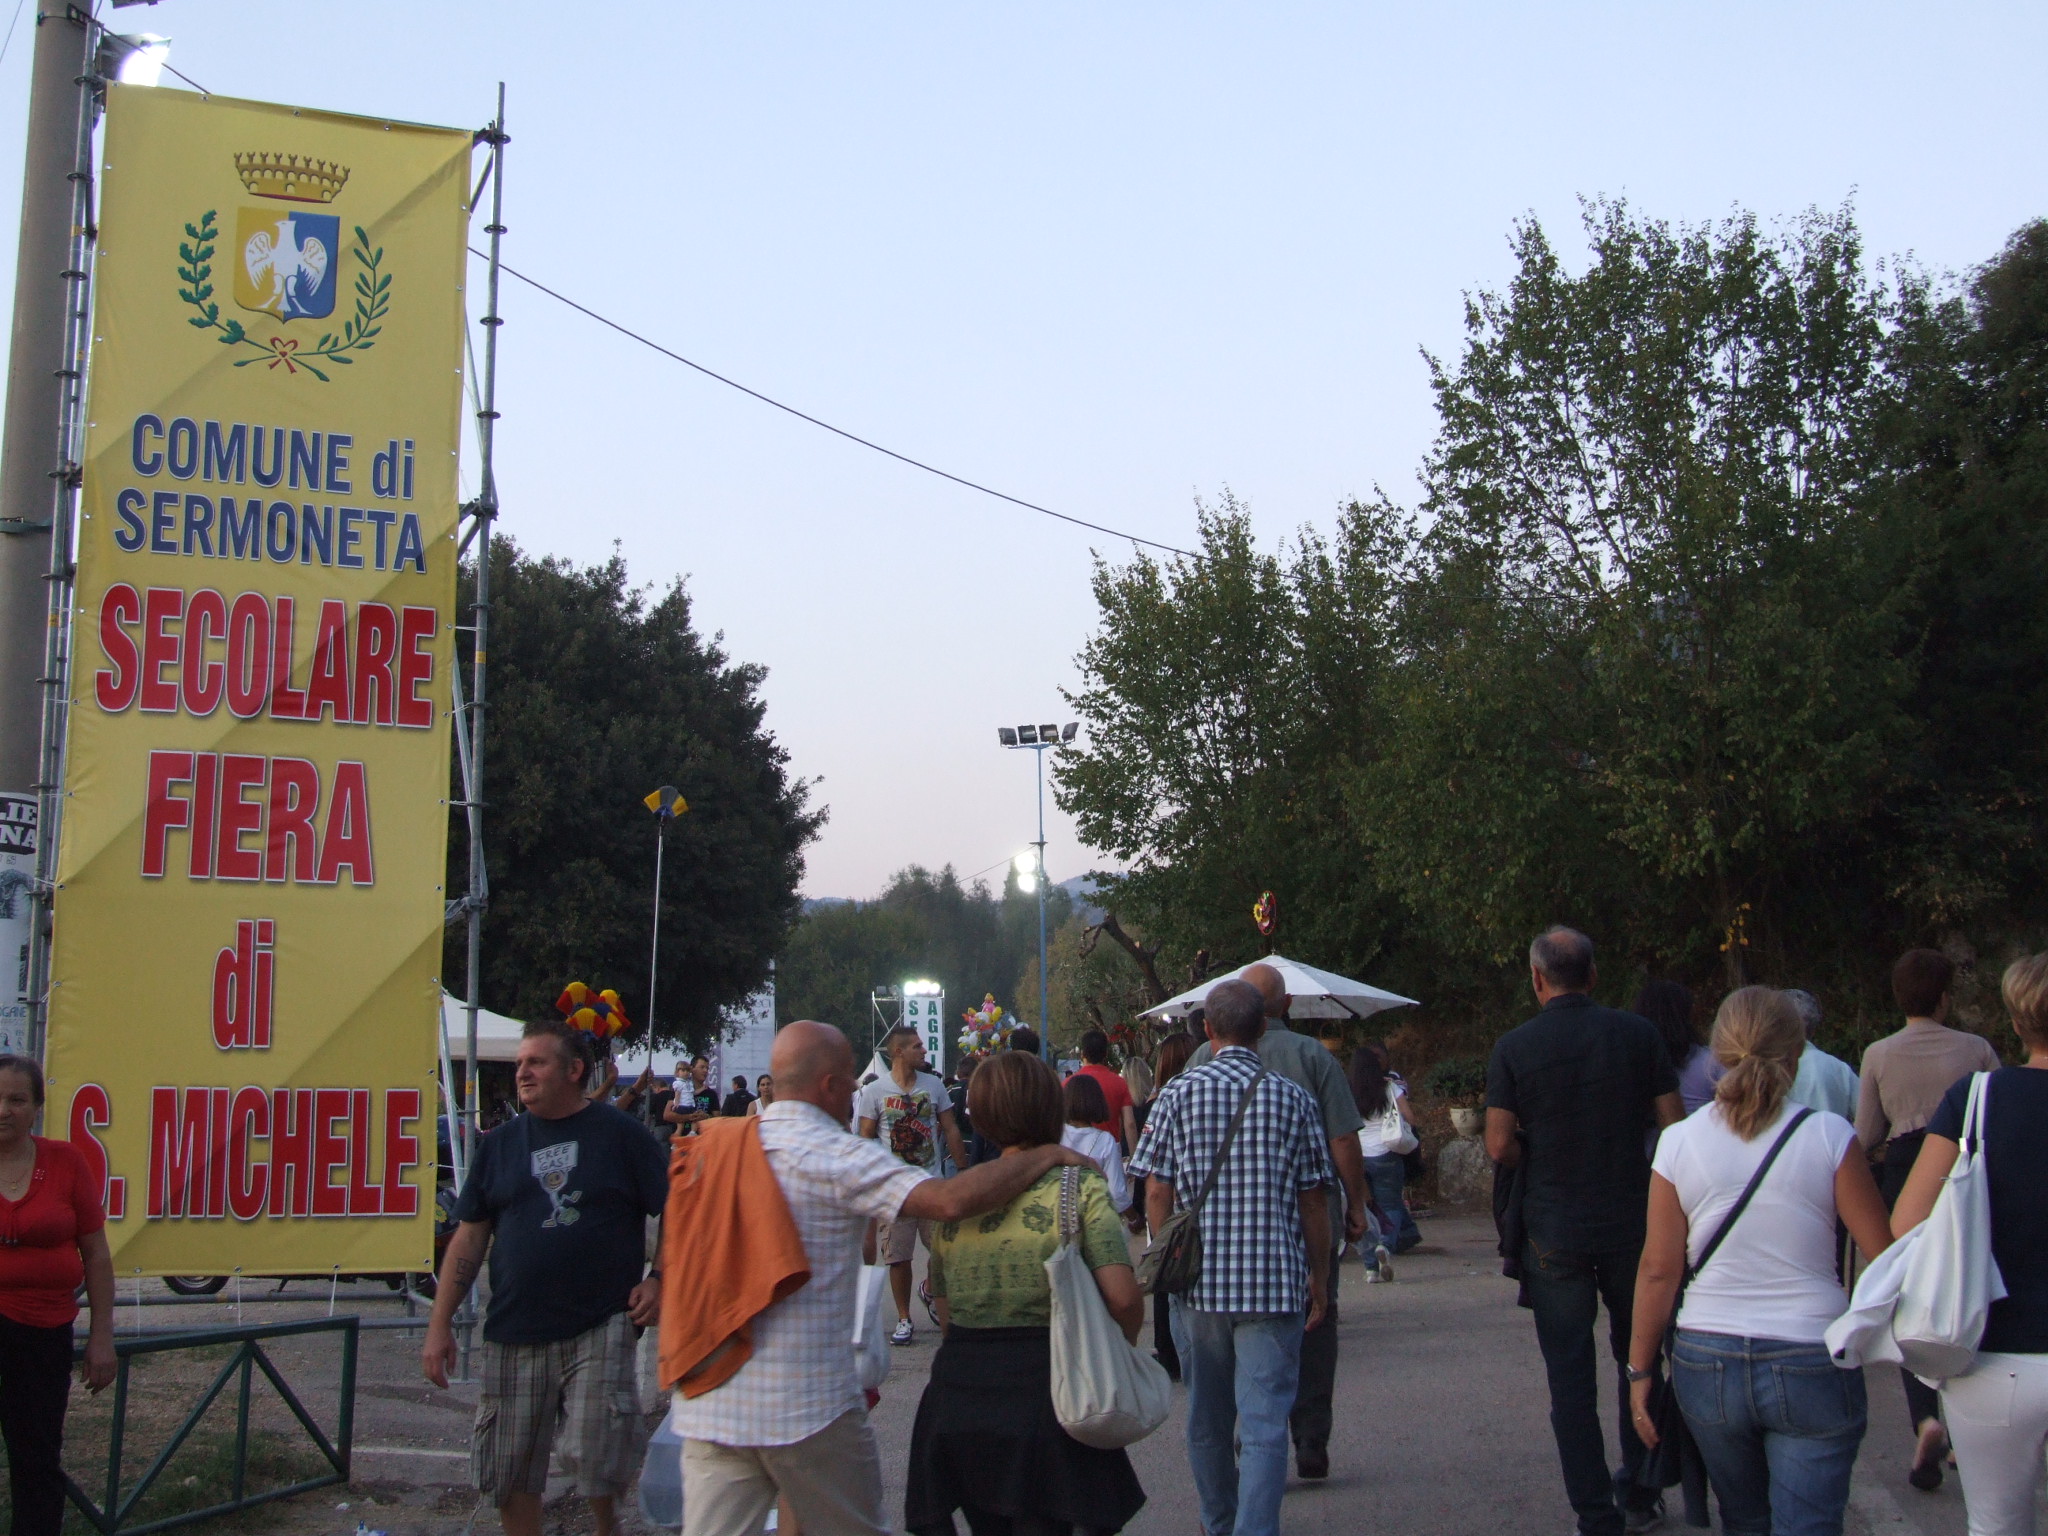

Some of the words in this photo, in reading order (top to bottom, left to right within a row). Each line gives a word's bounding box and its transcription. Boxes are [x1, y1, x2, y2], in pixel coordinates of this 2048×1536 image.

[132, 412, 353, 494] COMUNE
[372, 438, 415, 500] di
[114, 487, 427, 574] SERMONETA
[94, 582, 437, 729] SECOLARE
[140, 749, 375, 886] FIERA
[212, 918, 275, 1050] di
[145, 1085, 421, 1221] MICHELE
[536, 1143, 572, 1163] FREE
